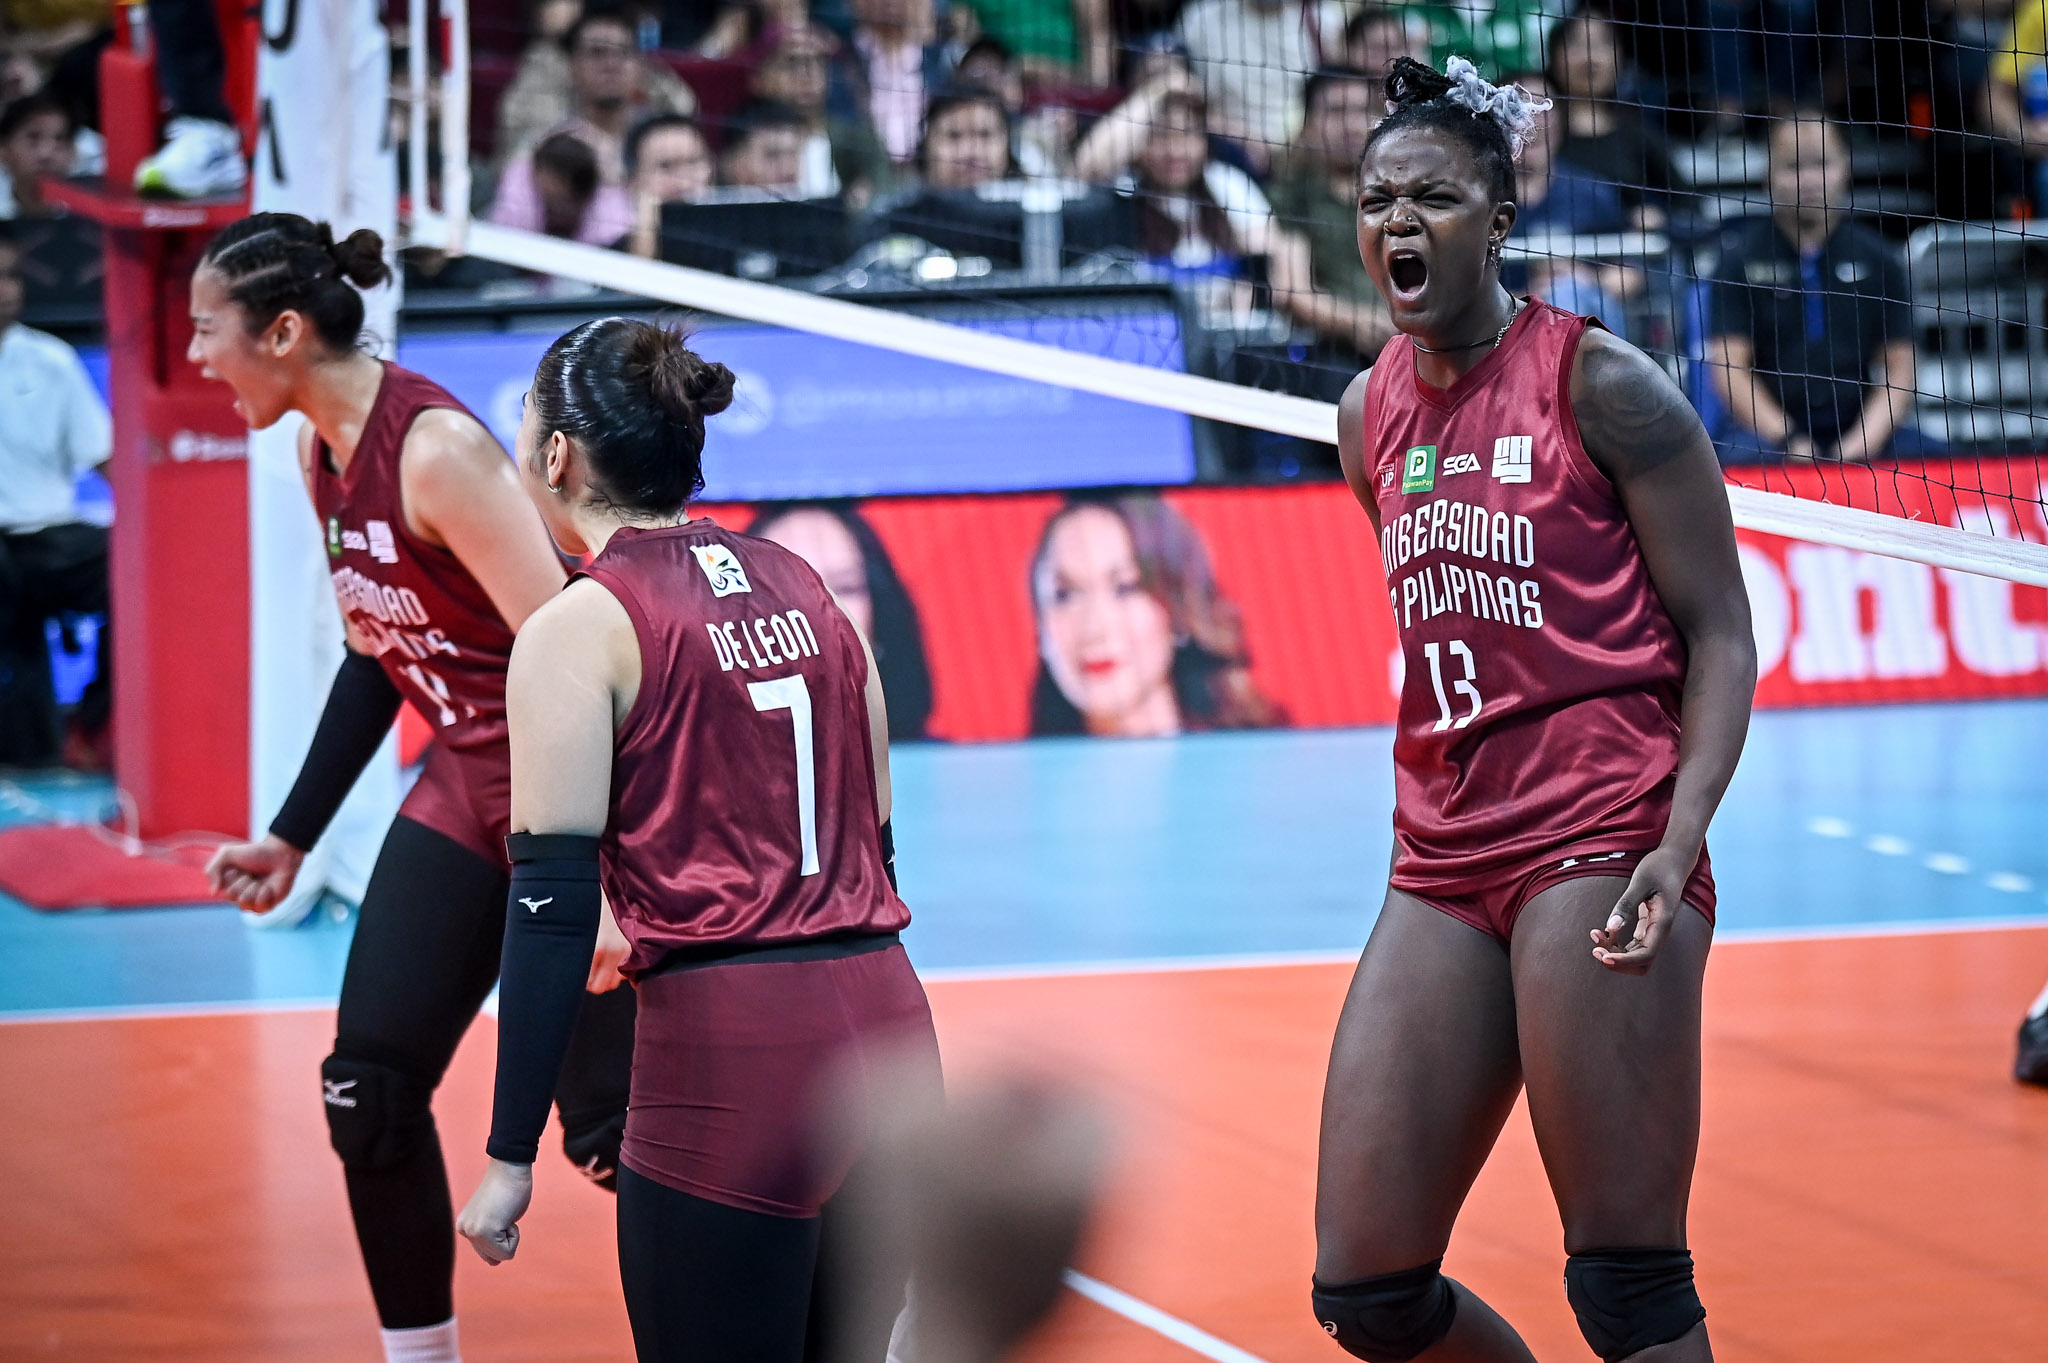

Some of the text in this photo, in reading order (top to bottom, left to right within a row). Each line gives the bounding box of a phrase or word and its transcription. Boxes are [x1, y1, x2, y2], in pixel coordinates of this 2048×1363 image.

[1442, 452, 1482, 477] SGA
[1381, 499, 1535, 580] NIBERSIDAD
[1402, 562, 1544, 629] PILIPINAS
[706, 609, 820, 672] DE LEON
[1424, 639, 1483, 733] 13
[746, 673, 821, 877] 7
